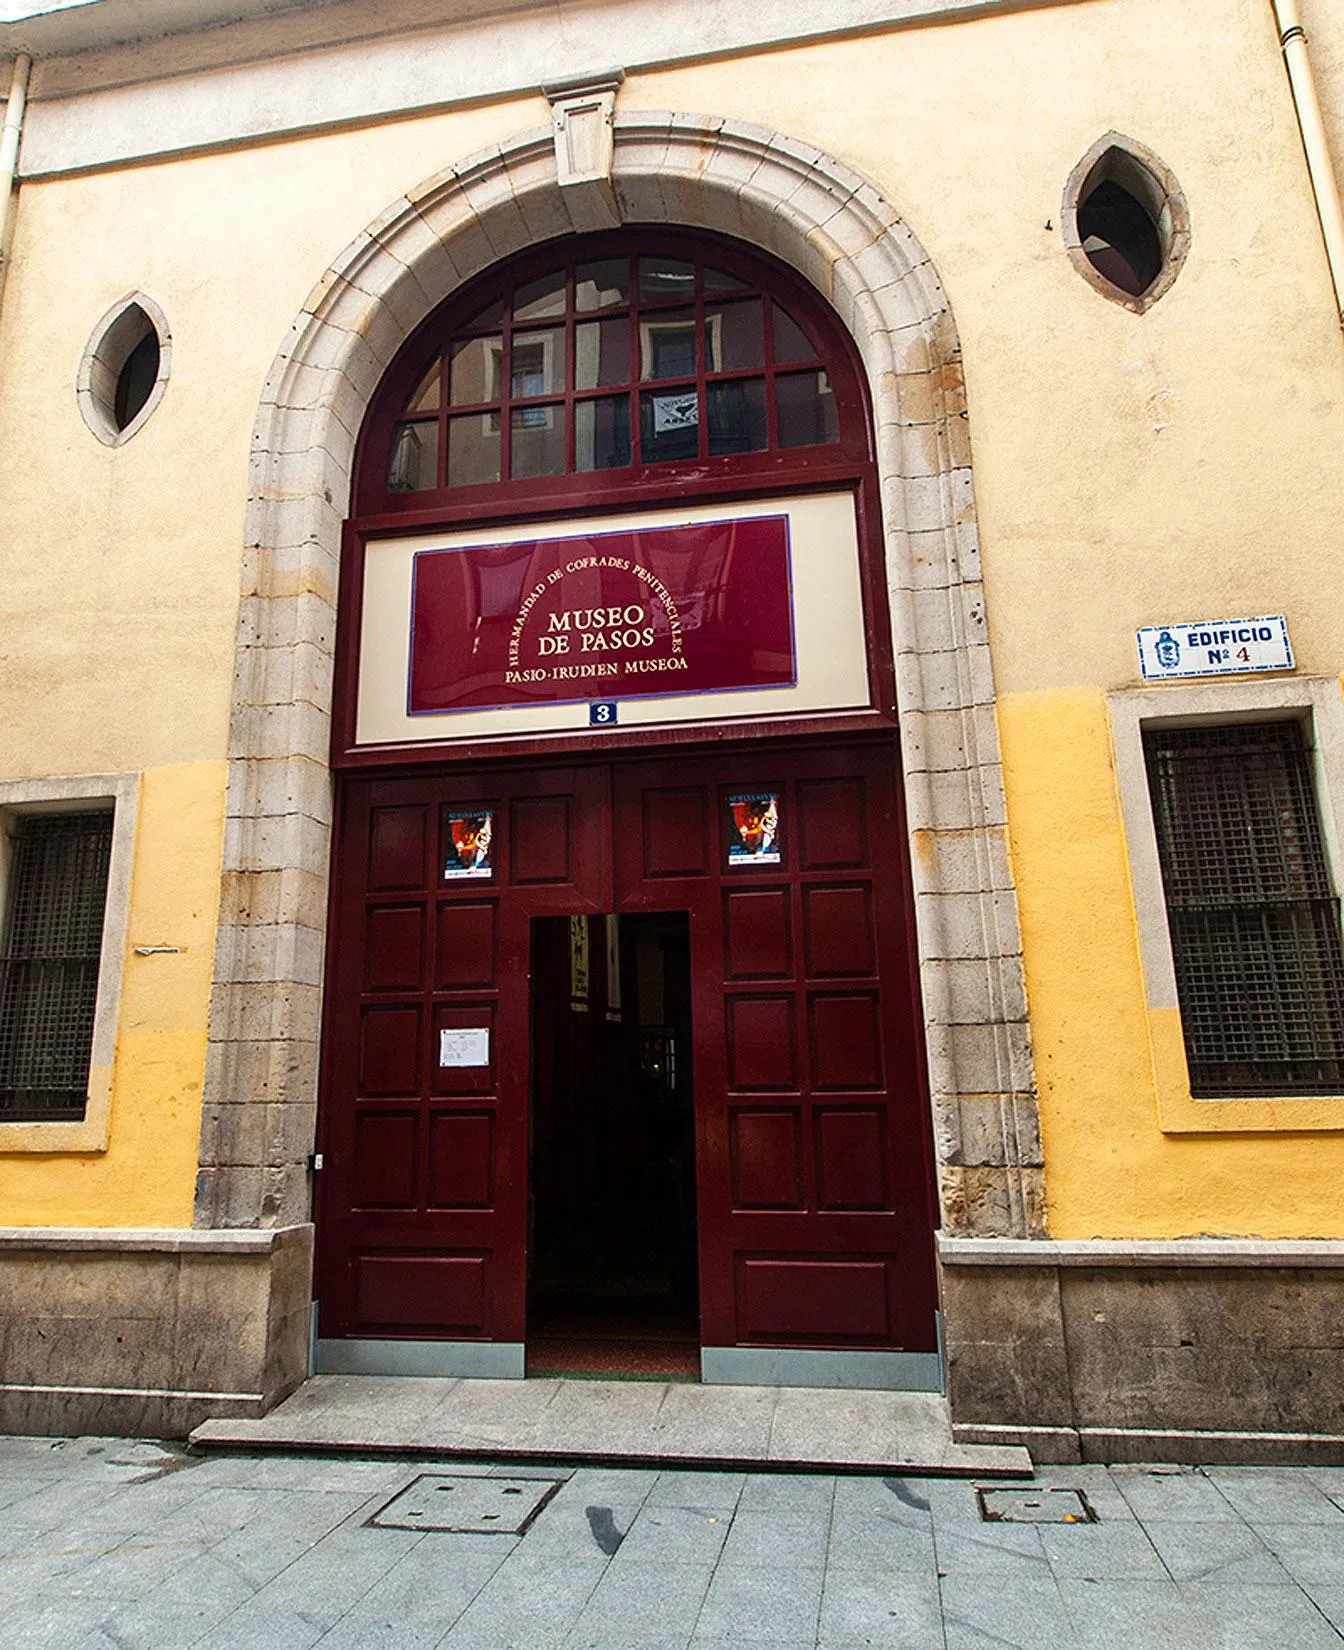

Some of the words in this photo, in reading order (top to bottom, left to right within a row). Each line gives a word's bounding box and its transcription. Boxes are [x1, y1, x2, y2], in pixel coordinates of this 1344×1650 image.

[509, 583, 545, 666] HERMANDAD
[547, 569, 563, 584] DE
[566, 557, 630, 573] COFRADES
[632, 565, 682, 653] PENITENCIALES
[548, 605, 644, 632] MUSEO
[538, 636, 570, 655] DE
[581, 628, 654, 652] PASOS
[1188, 627, 1272, 647] EDIFICIO
[1236, 647, 1250, 662] 4
[625, 657, 688, 674] MUSEOA
[596, 704, 610, 722] 3
